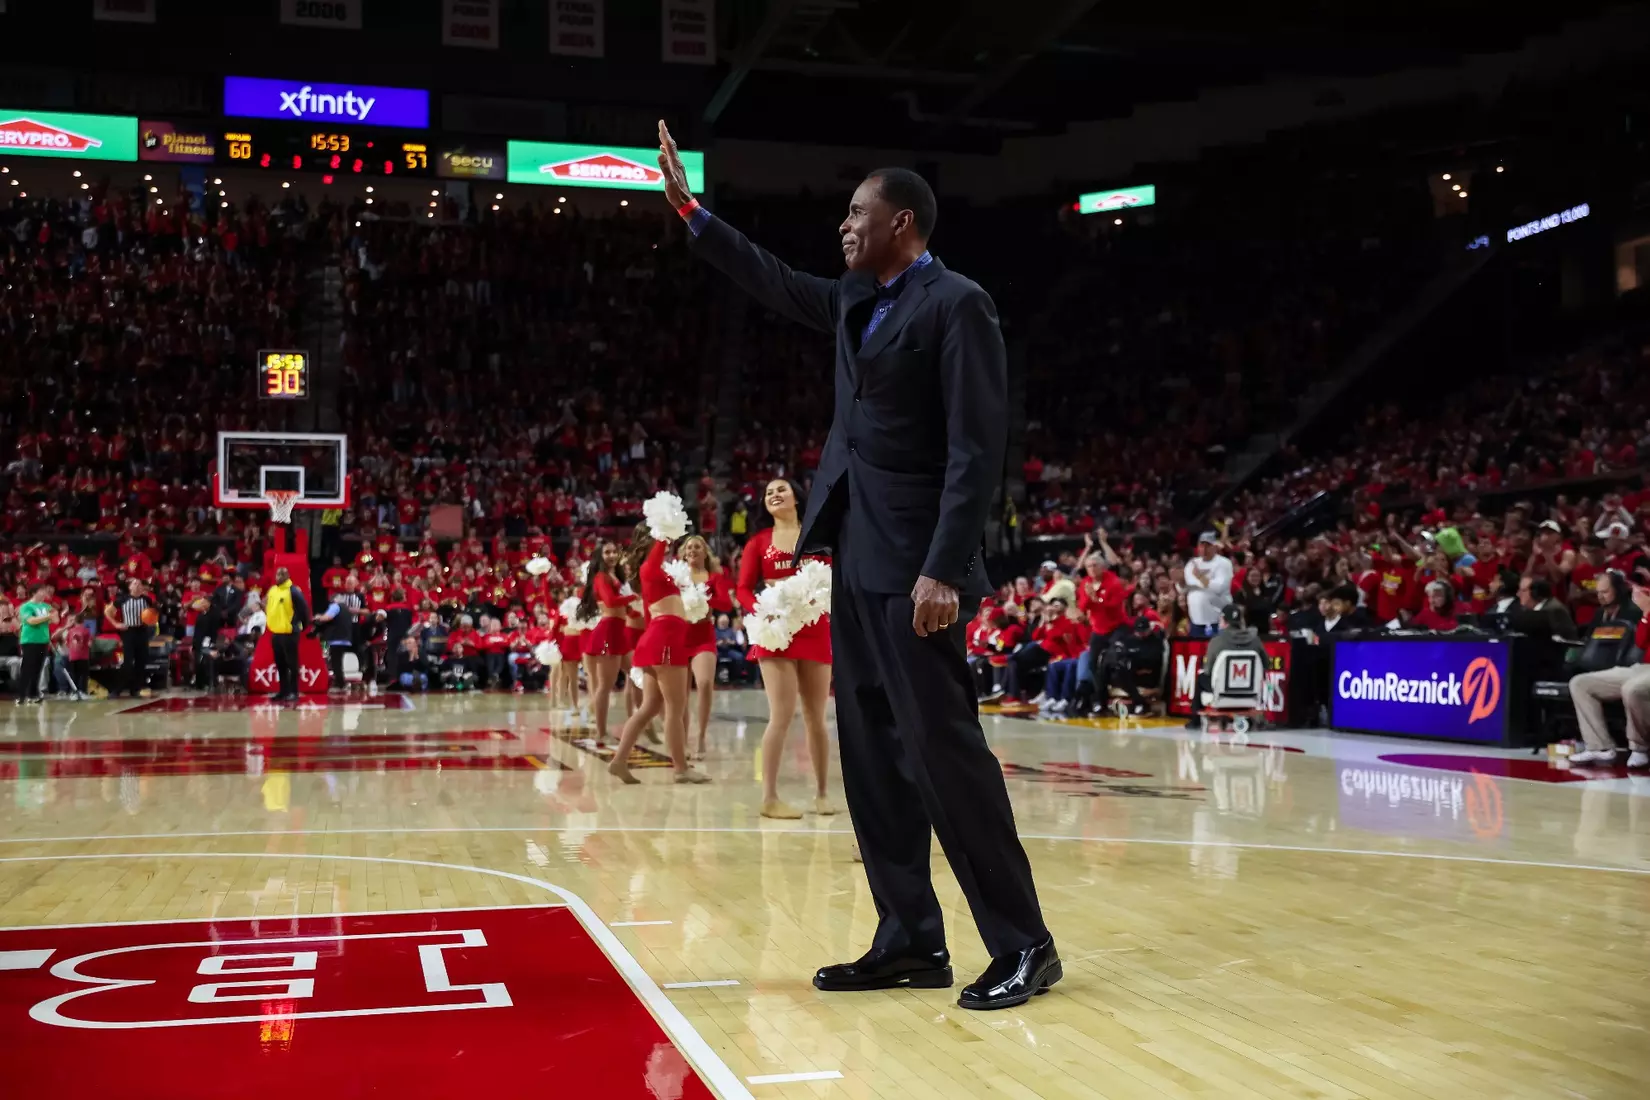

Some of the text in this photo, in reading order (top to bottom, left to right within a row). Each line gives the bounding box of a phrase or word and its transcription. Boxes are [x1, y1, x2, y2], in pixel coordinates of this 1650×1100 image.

[279, 85, 376, 121] xfinity
[162, 132, 206, 146] planet
[311, 133, 350, 152] 15:53
[168, 143, 215, 156] fitness
[229, 142, 252, 159] 60
[405, 152, 427, 169] 57
[267, 353, 303, 370] 15:53
[267, 369, 300, 394] 30
[254, 662, 322, 687] xfity
[1338, 669, 1462, 706] CohnReznick
